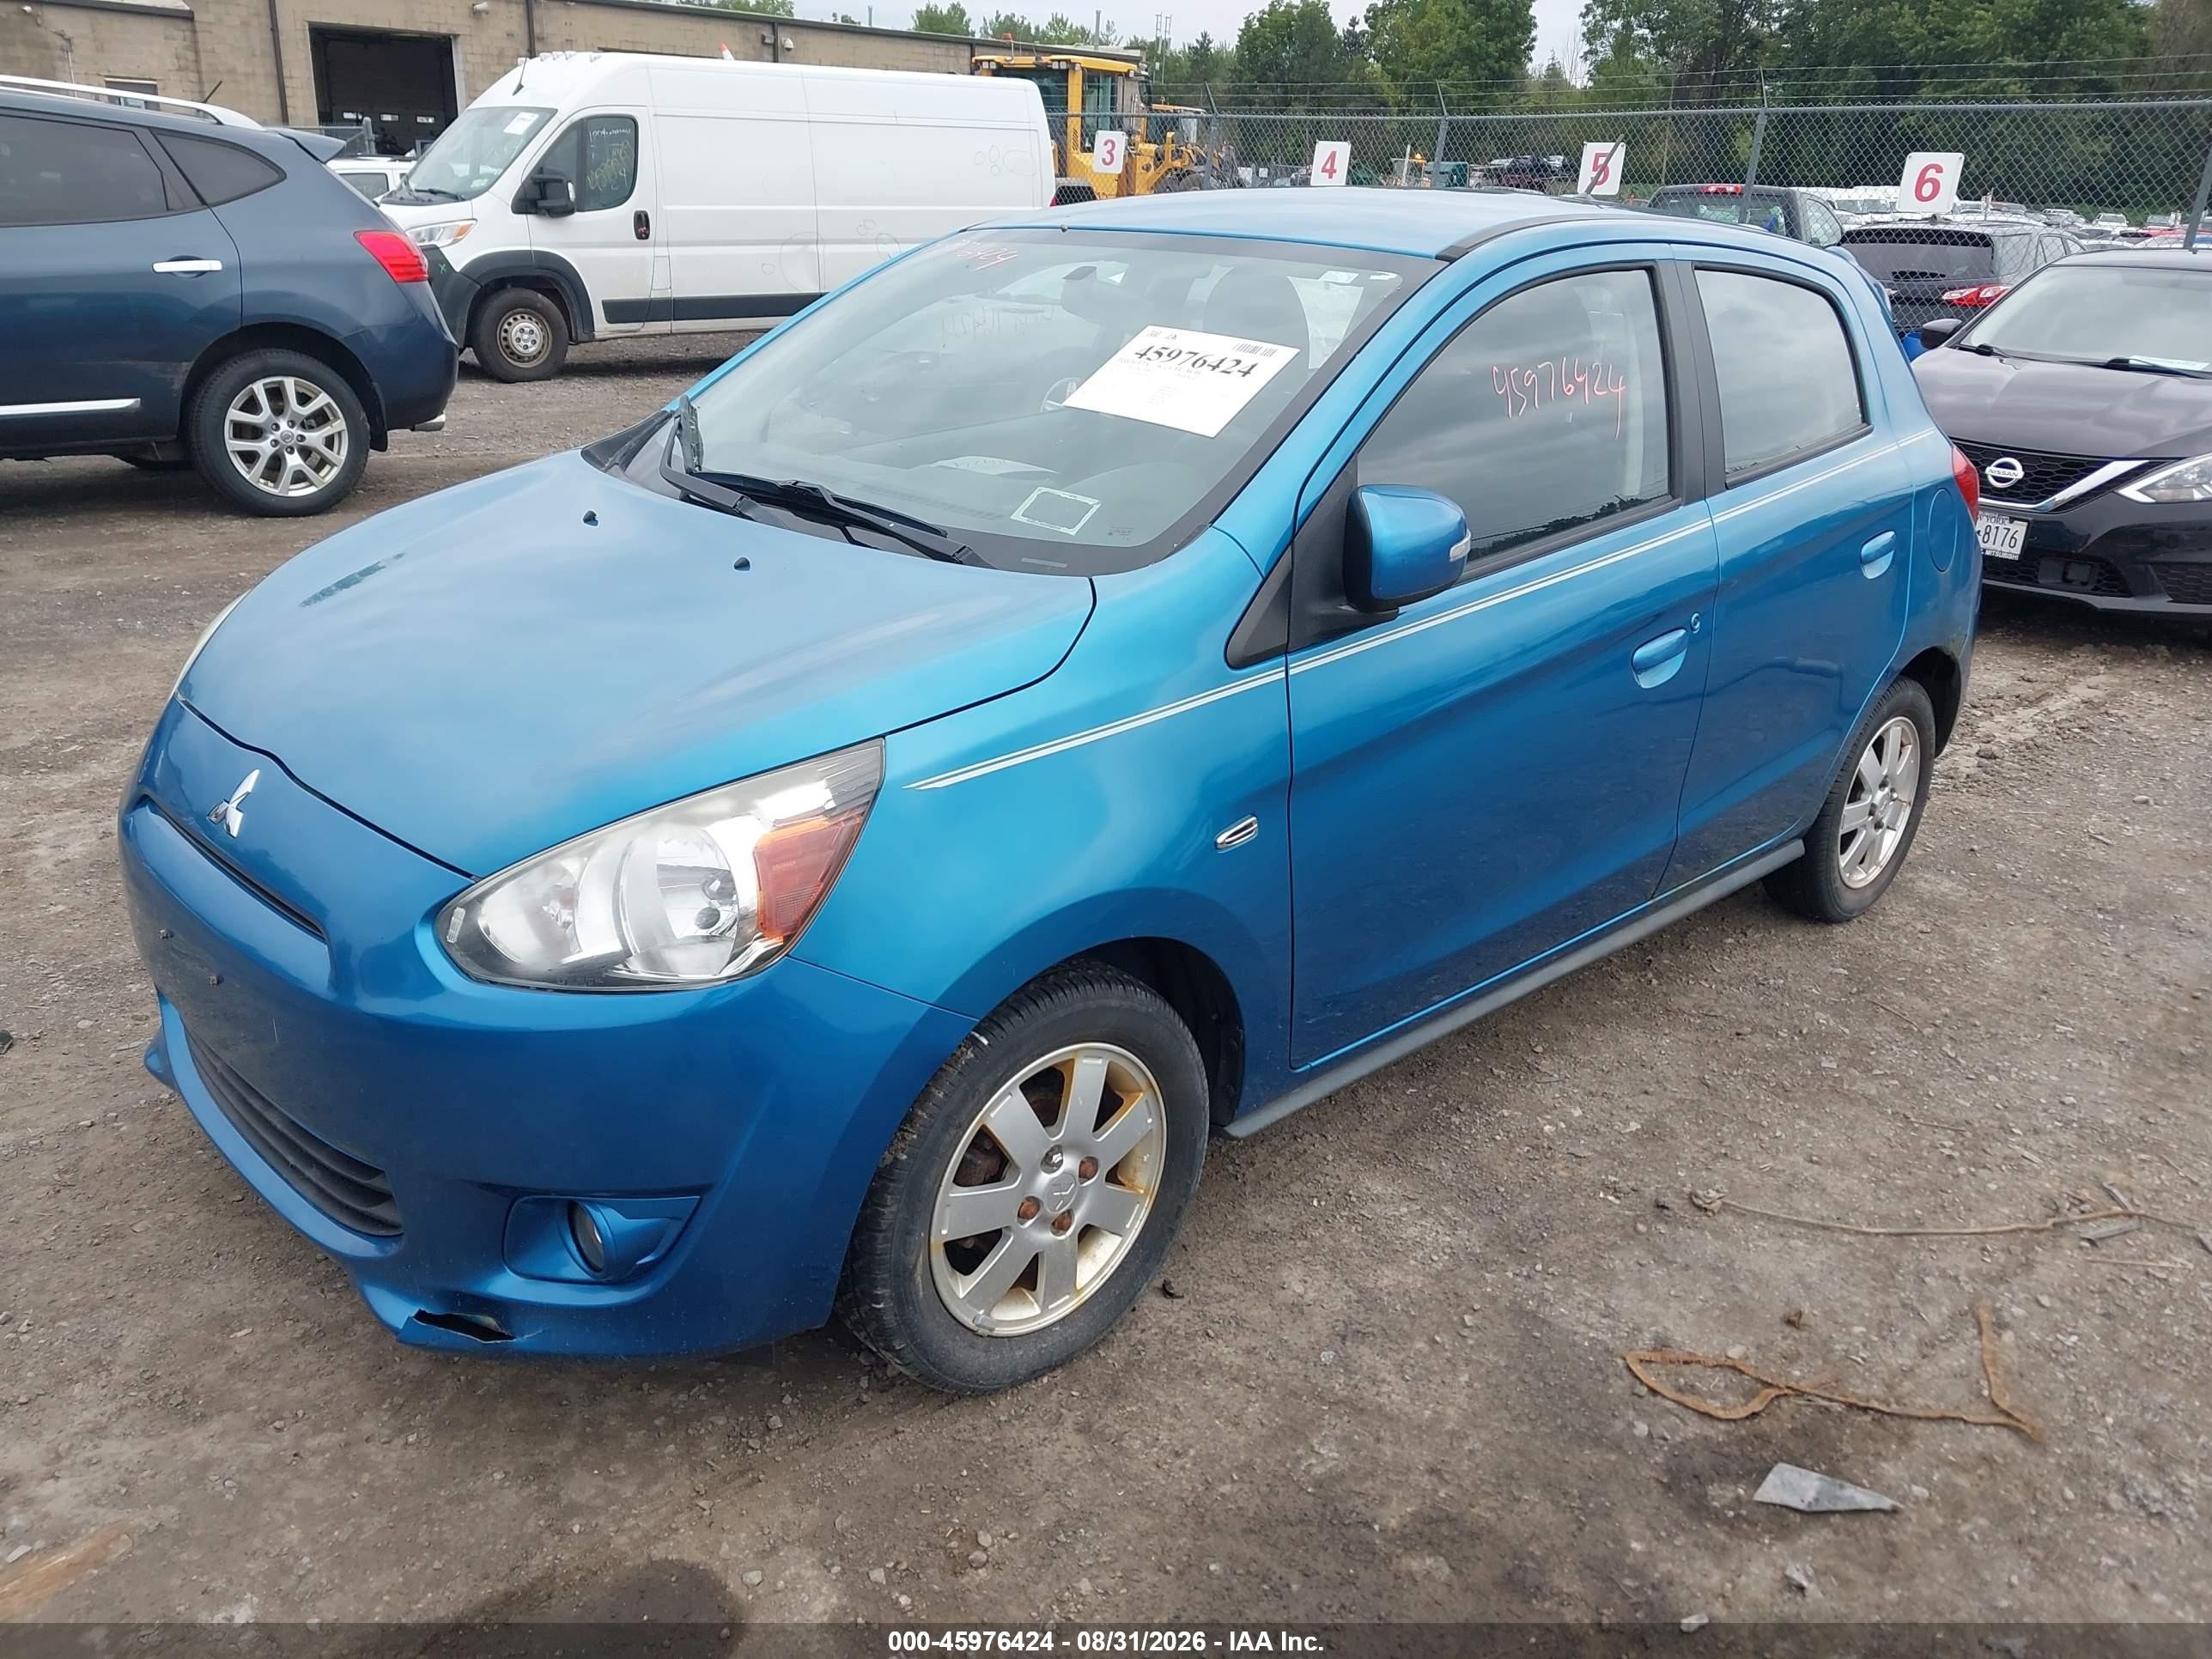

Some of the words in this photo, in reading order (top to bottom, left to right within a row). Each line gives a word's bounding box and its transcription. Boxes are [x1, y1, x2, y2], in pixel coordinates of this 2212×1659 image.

[1101, 138, 1116, 167] 3
[1320, 150, 1338, 179] 4
[1590, 152, 1611, 186] 5
[1914, 163, 1944, 203] 6
[1133, 344, 1260, 378] 45976424
[1492, 356, 1626, 438] 45976424
[1989, 468, 2019, 477] NISSAN
[1984, 549, 2020, 561] MITSUBISHI
